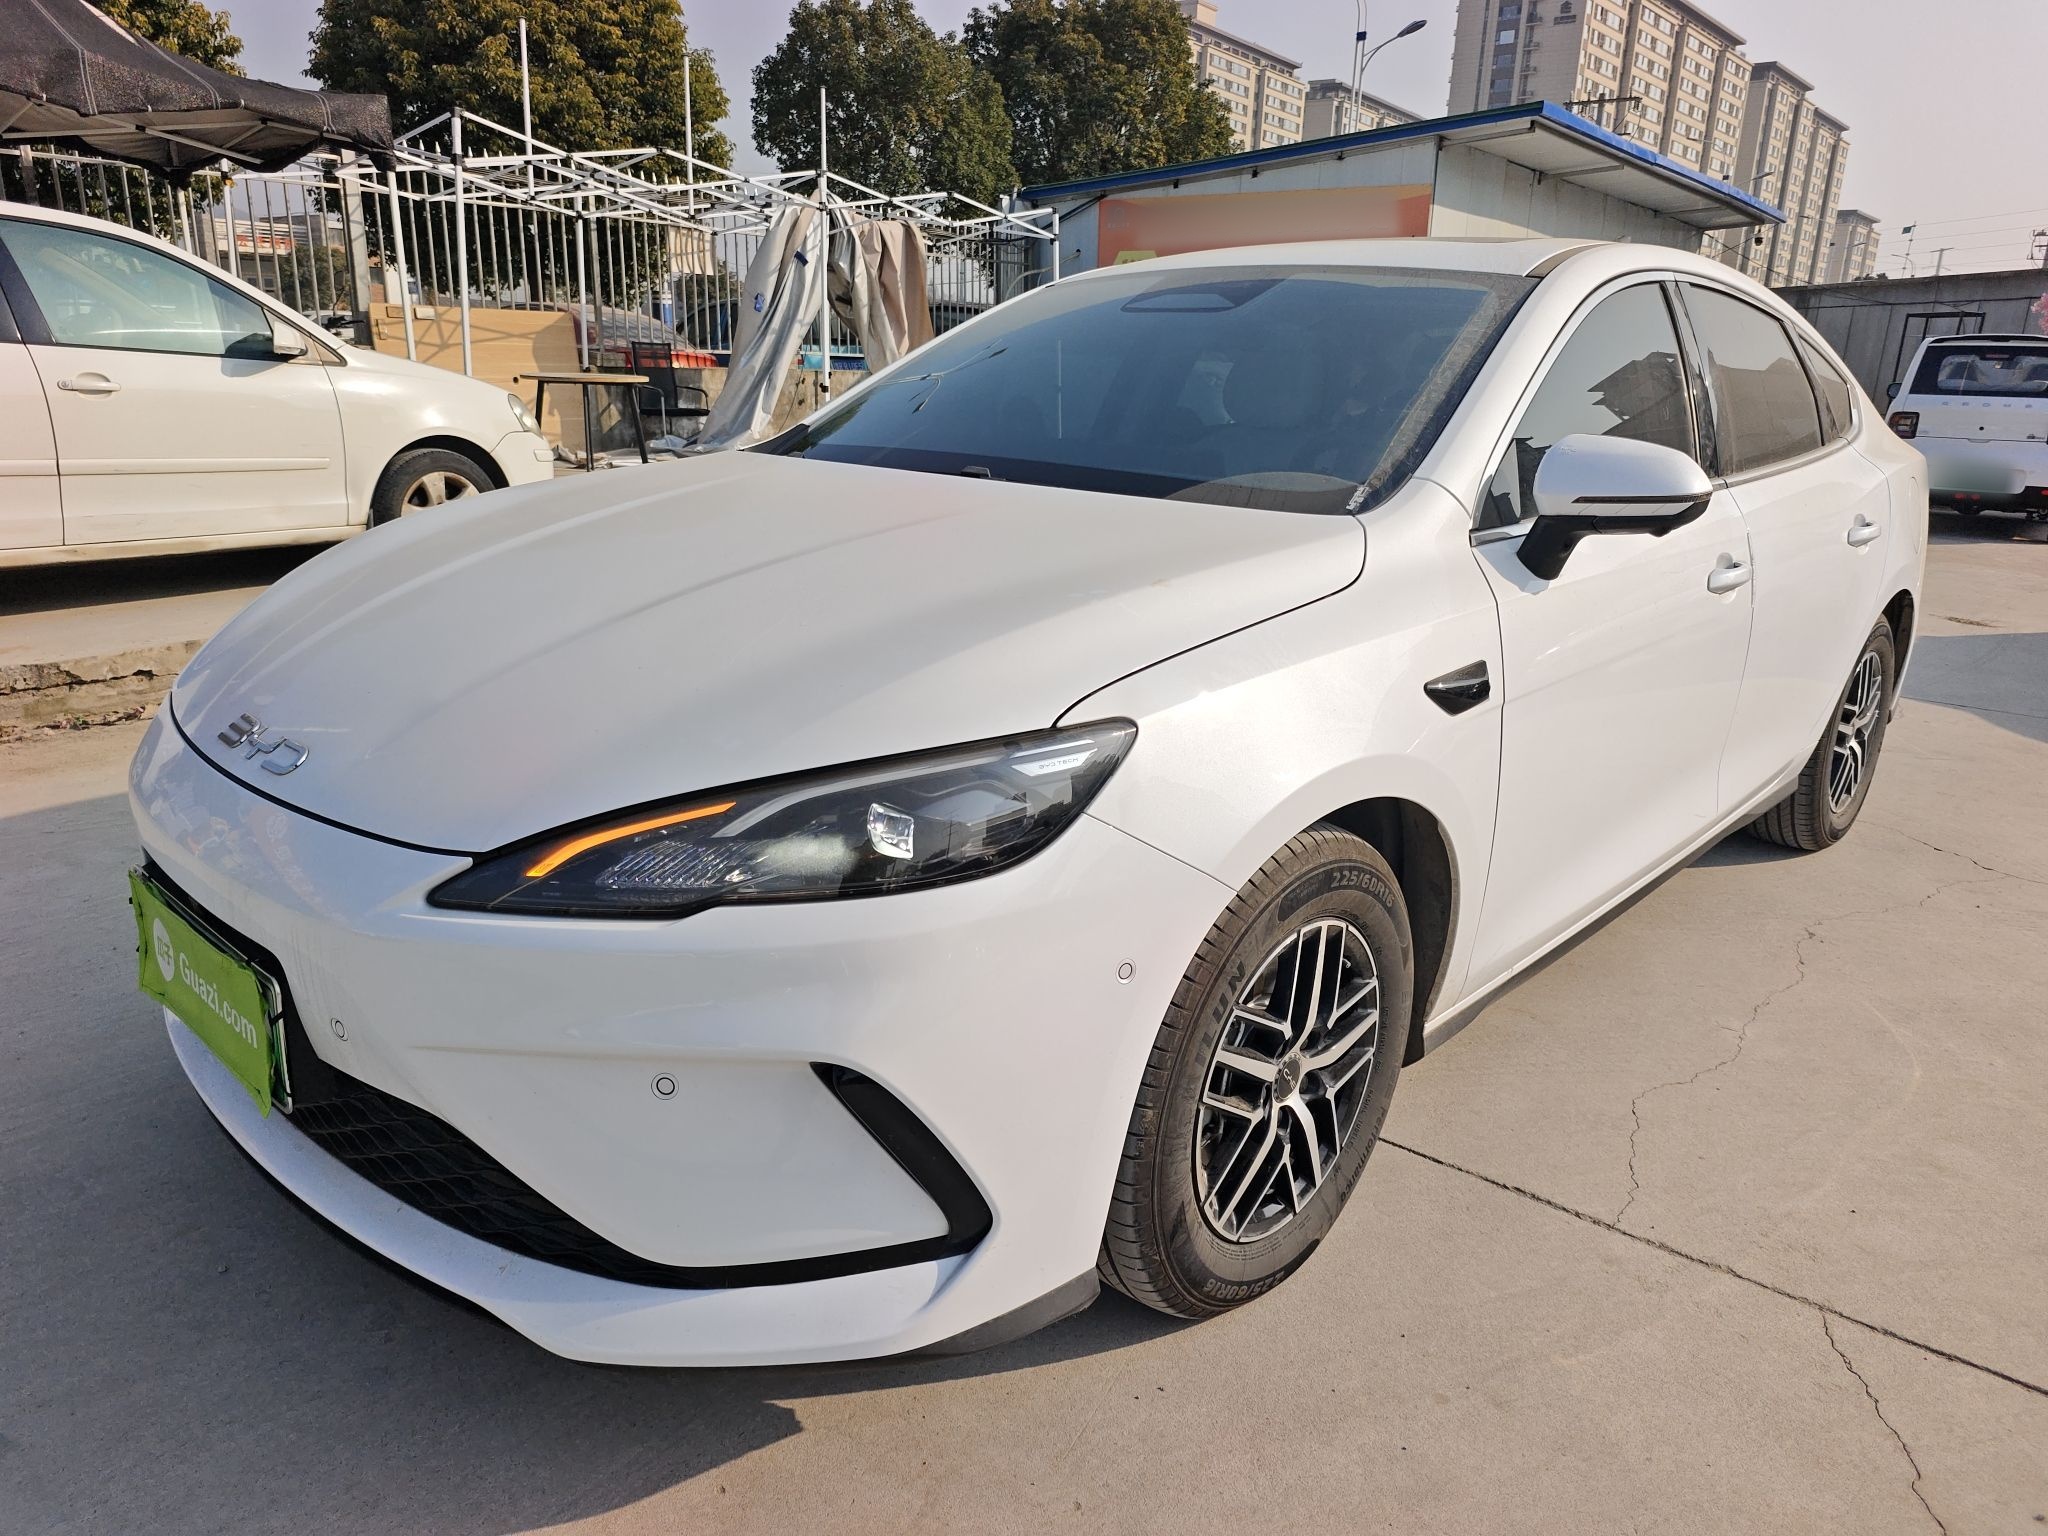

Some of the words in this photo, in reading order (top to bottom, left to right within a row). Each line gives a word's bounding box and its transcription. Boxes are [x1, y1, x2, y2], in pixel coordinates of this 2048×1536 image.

[217, 712, 310, 776] BYD
[1057, 757, 1079, 766] TECH
[1330, 870, 1395, 909] 225/60R16
[178, 952, 258, 1049] Guazi.com
[1203, 1270, 1285, 1300] 225/60R16
